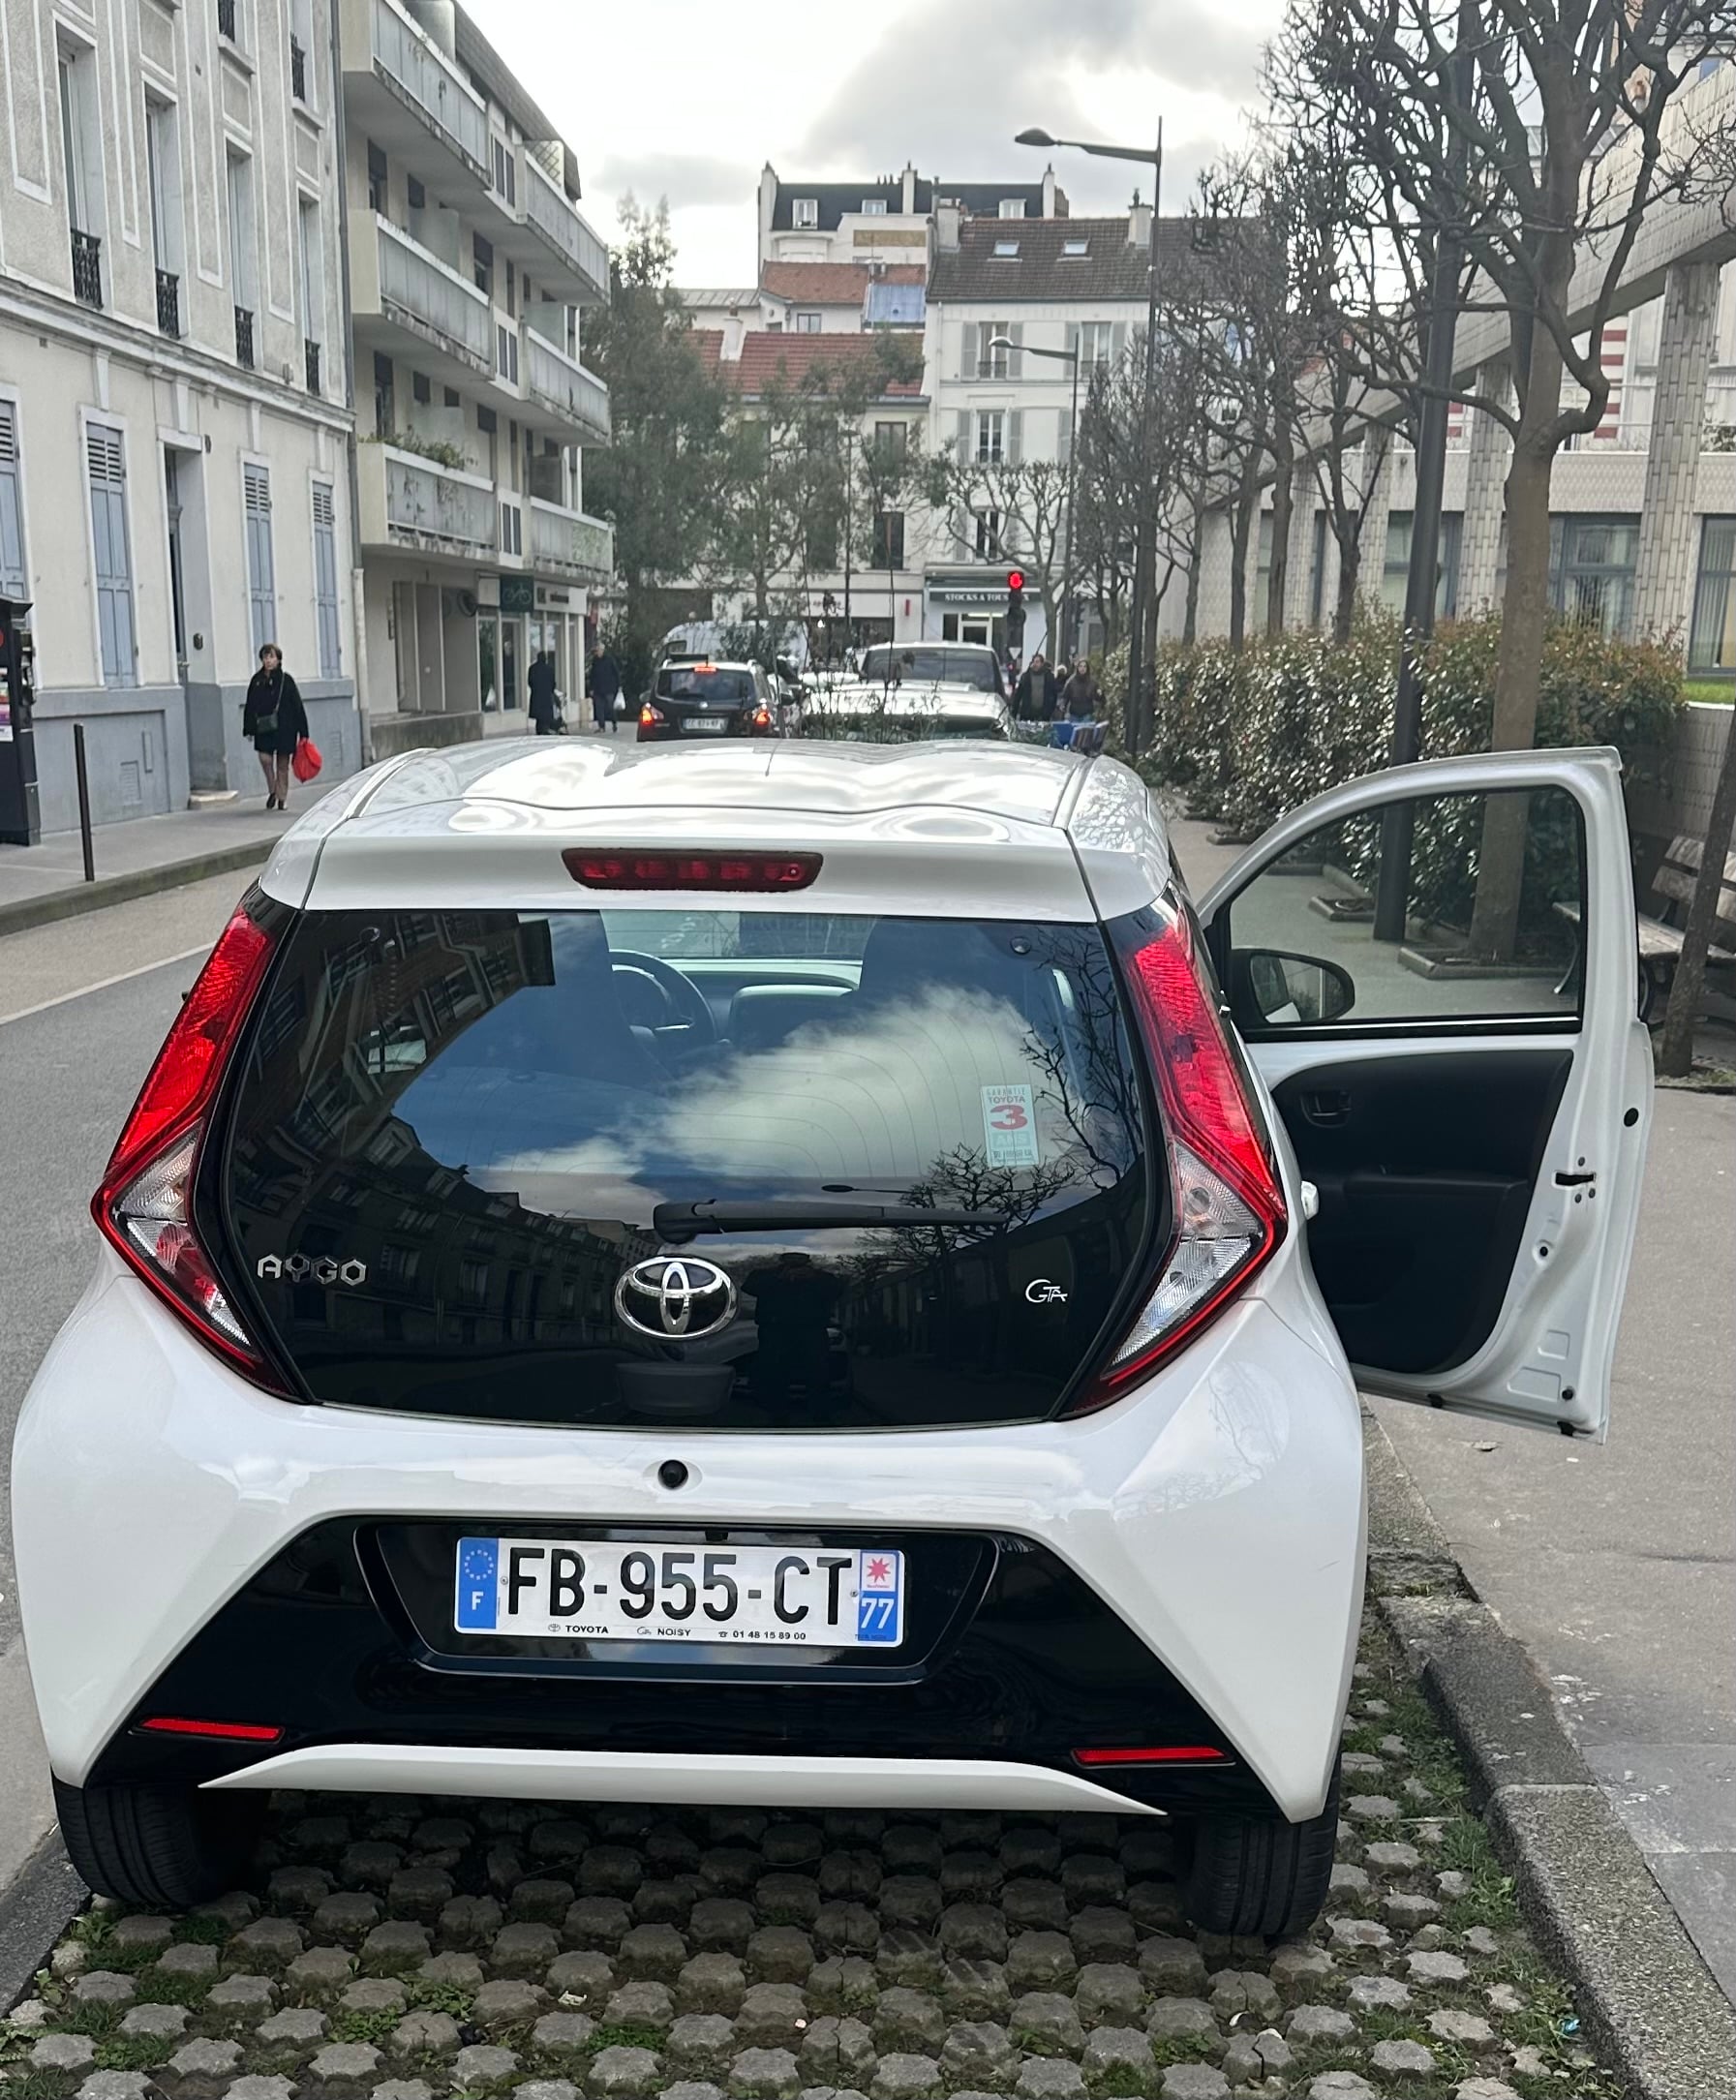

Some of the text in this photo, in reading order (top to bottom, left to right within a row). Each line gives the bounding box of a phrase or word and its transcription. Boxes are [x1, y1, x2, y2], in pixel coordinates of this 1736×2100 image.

[988, 1095, 1026, 1104] TOYOTA
[990, 1104, 1028, 1131] 3
[257, 1253, 367, 1287] AYGO
[508, 1546, 853, 1625] FB-955-CT
[471, 1591, 484, 1611] F
[860, 1597, 896, 1629] 77
[565, 1625, 609, 1634] TOYOTA
[656, 1628, 691, 1636] NOISY
